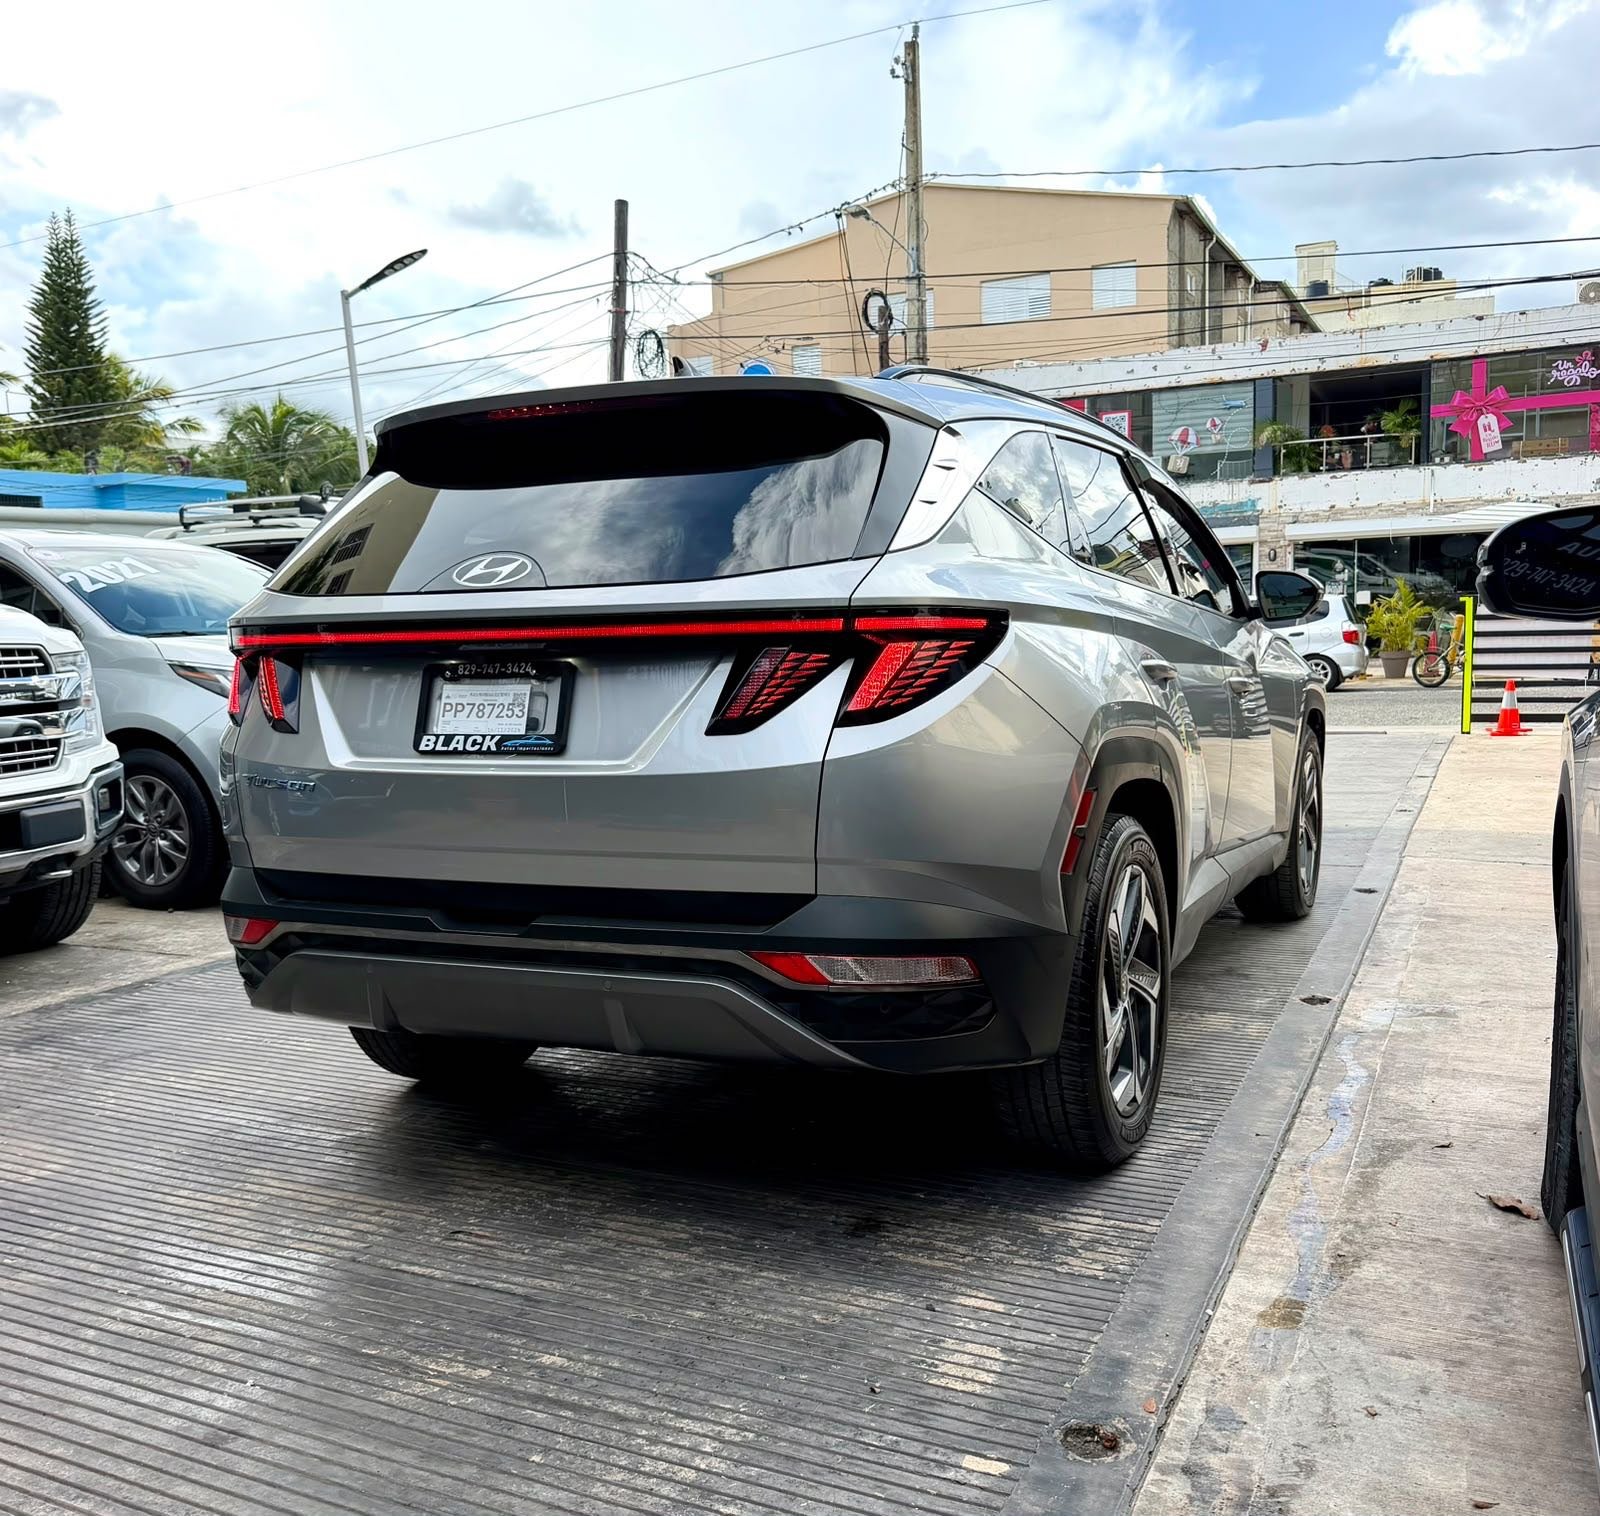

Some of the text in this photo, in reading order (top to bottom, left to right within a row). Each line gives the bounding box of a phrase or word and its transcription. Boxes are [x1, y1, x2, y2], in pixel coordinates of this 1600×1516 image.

[1551, 360, 1574, 371] Un
[1555, 541, 1600, 561] AU
[58, 557, 161, 593] 2021
[457, 662, 532, 676] 829-747-3424
[441, 701, 527, 719] PP787253
[418, 735, 502, 752] BLACK
